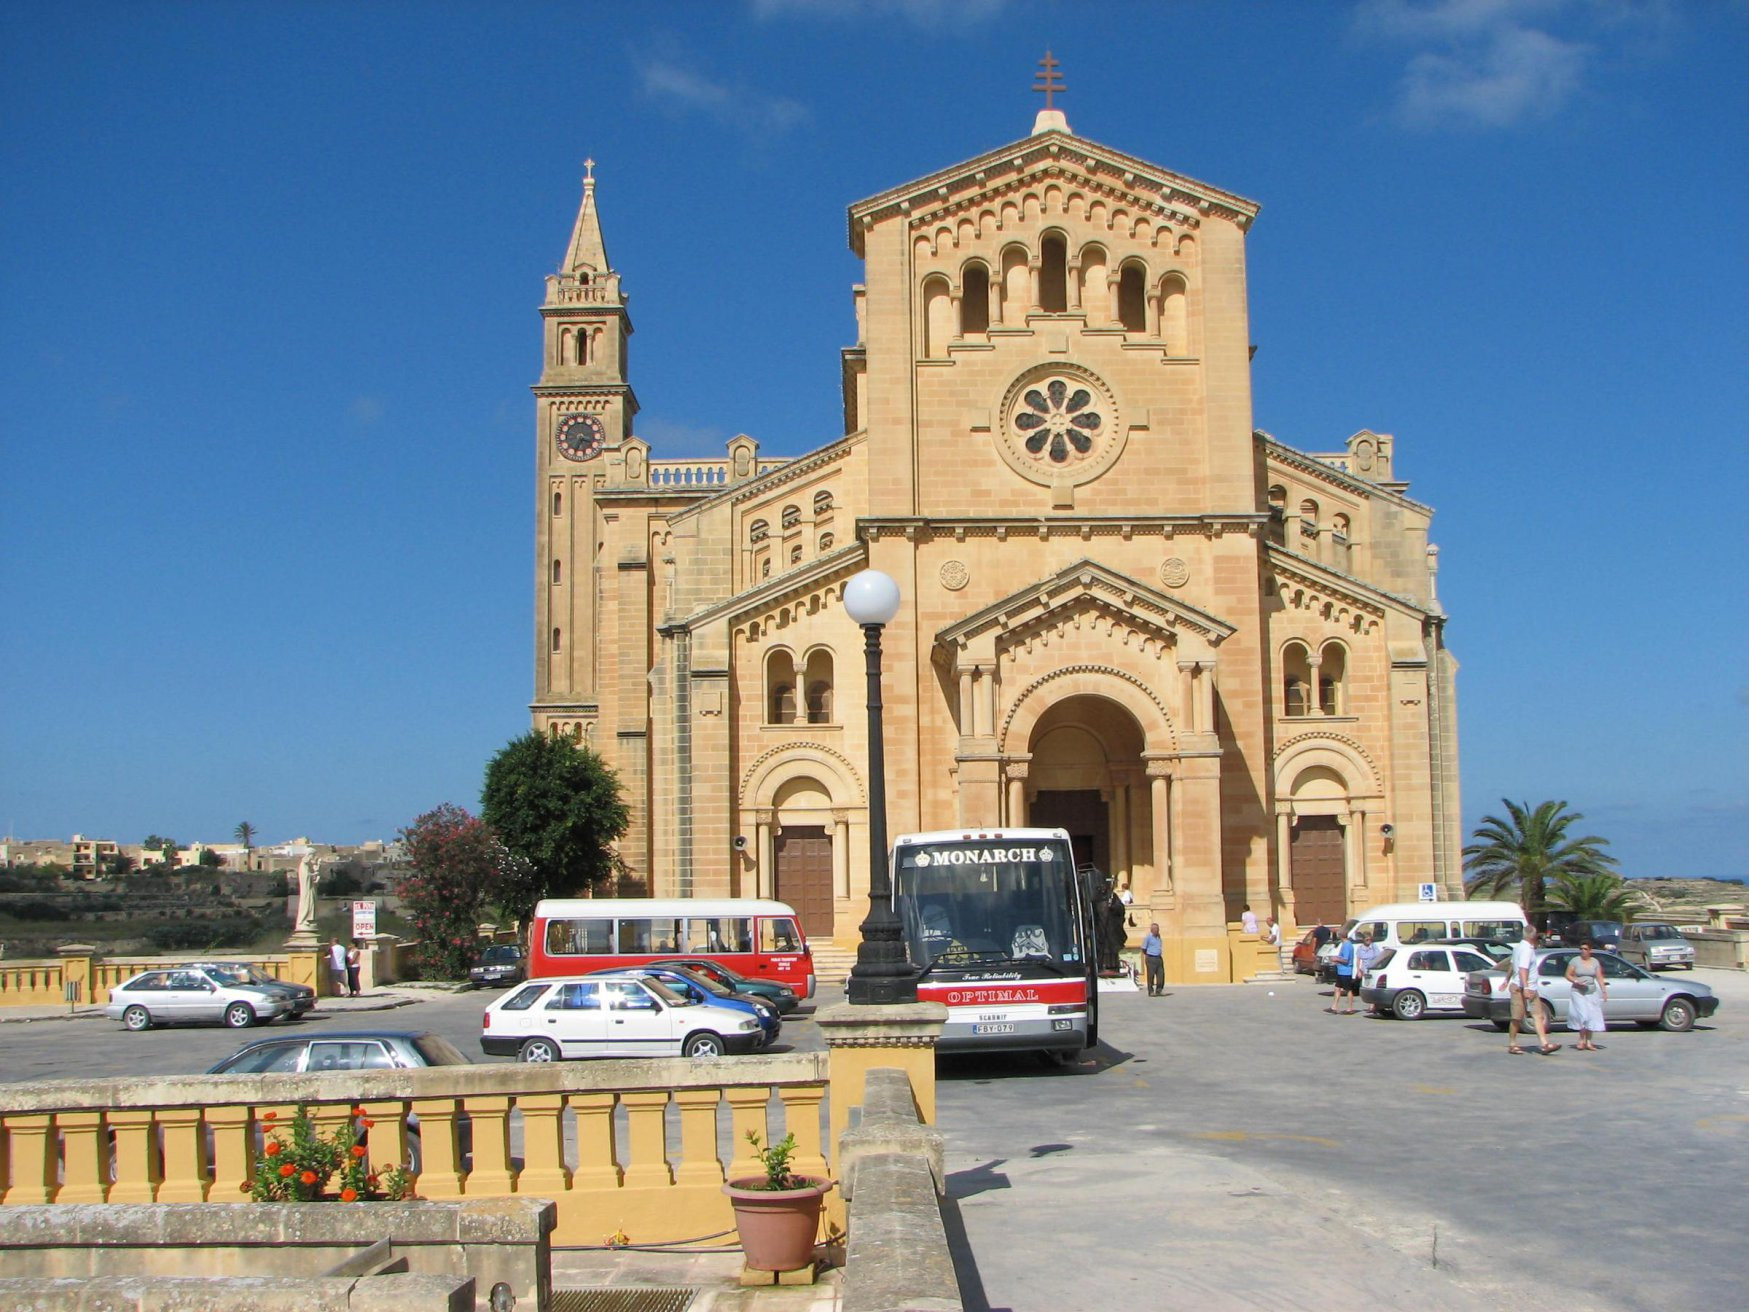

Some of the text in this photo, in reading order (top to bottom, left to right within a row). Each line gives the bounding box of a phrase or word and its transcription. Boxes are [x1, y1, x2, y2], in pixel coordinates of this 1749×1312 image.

[932, 848, 1037, 866] MONARCH
[355, 922, 374, 930] OPEN
[981, 972, 1022, 980] Reliability
[948, 989, 1039, 1002] OPTIMAL
